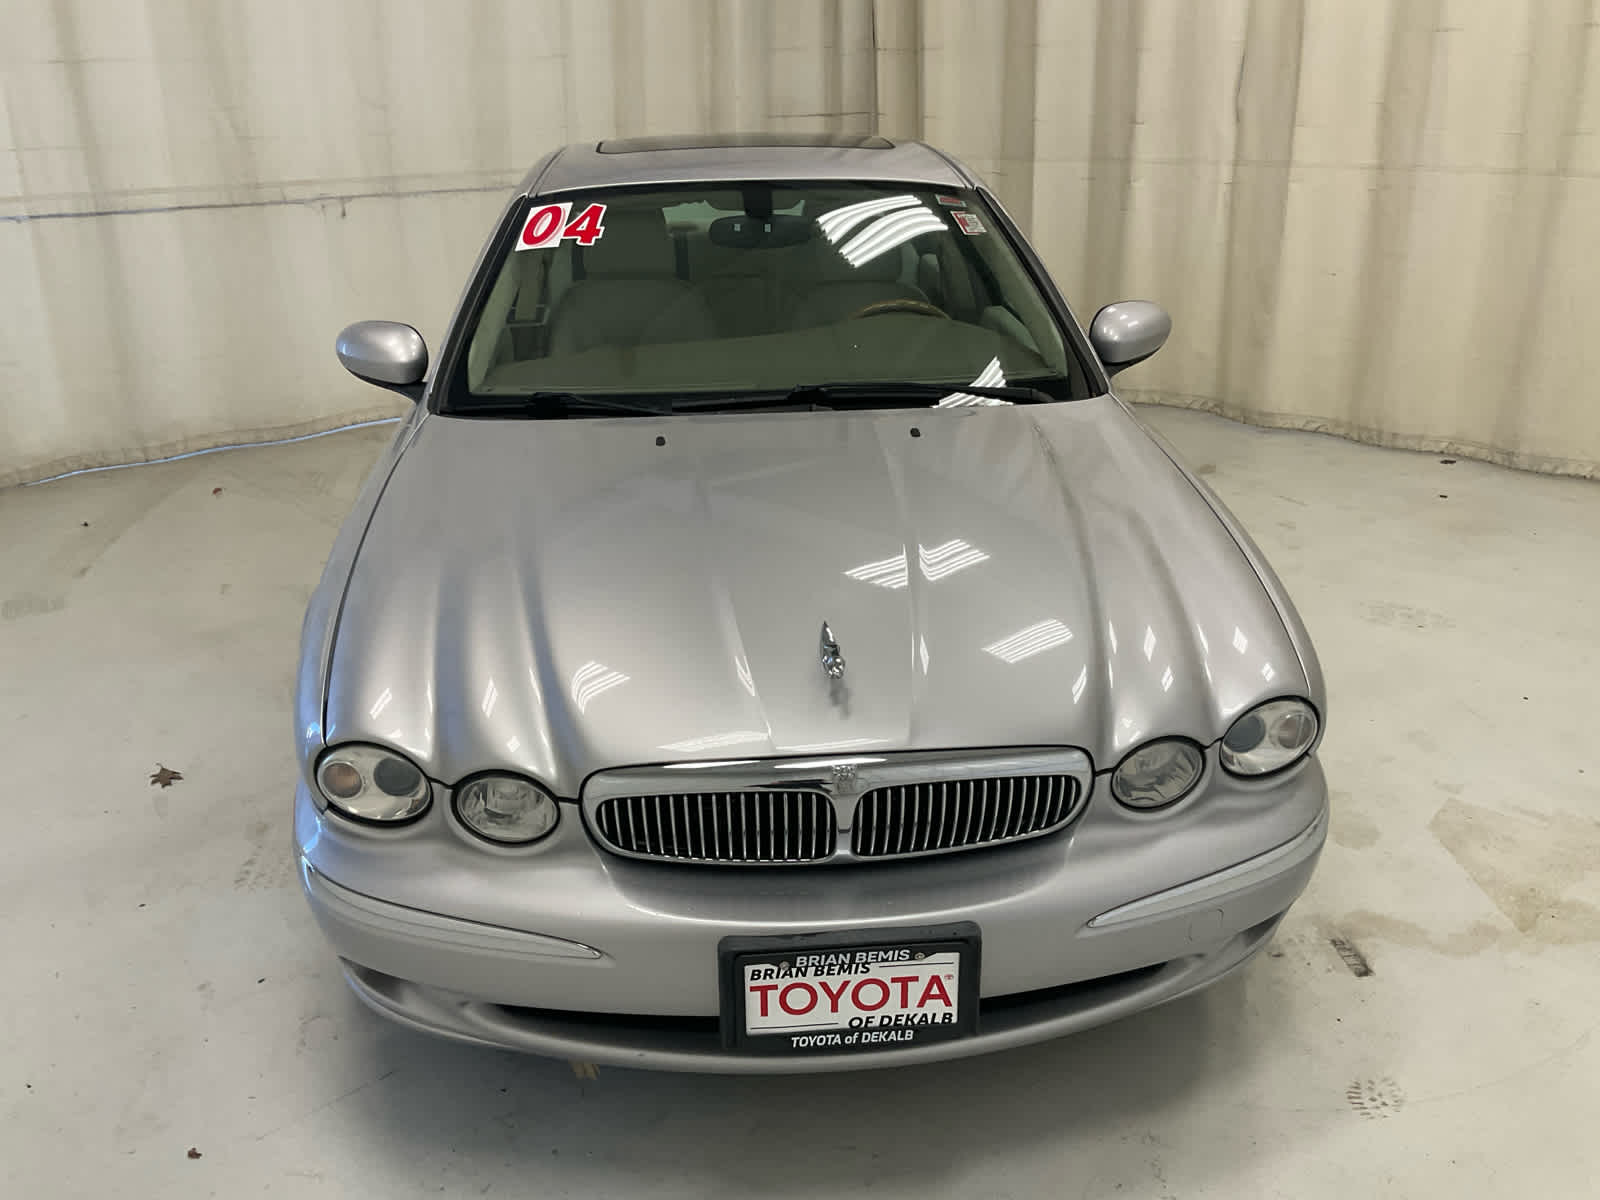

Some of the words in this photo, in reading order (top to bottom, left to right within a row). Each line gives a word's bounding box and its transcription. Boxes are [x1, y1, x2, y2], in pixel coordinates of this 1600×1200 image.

[522, 203, 607, 246] 04
[796, 953, 850, 967] BRIAN
[855, 950, 910, 963] BEMIS
[750, 967, 808, 981] BRIAN
[813, 964, 871, 977] BEMIS
[750, 975, 952, 1016] TOYOTA
[848, 1016, 875, 1028] OF
[879, 1013, 953, 1027] DEKALB
[791, 1033, 842, 1048] TOYOTA
[844, 1032, 860, 1045] of
[861, 1030, 914, 1043] DEKALB
